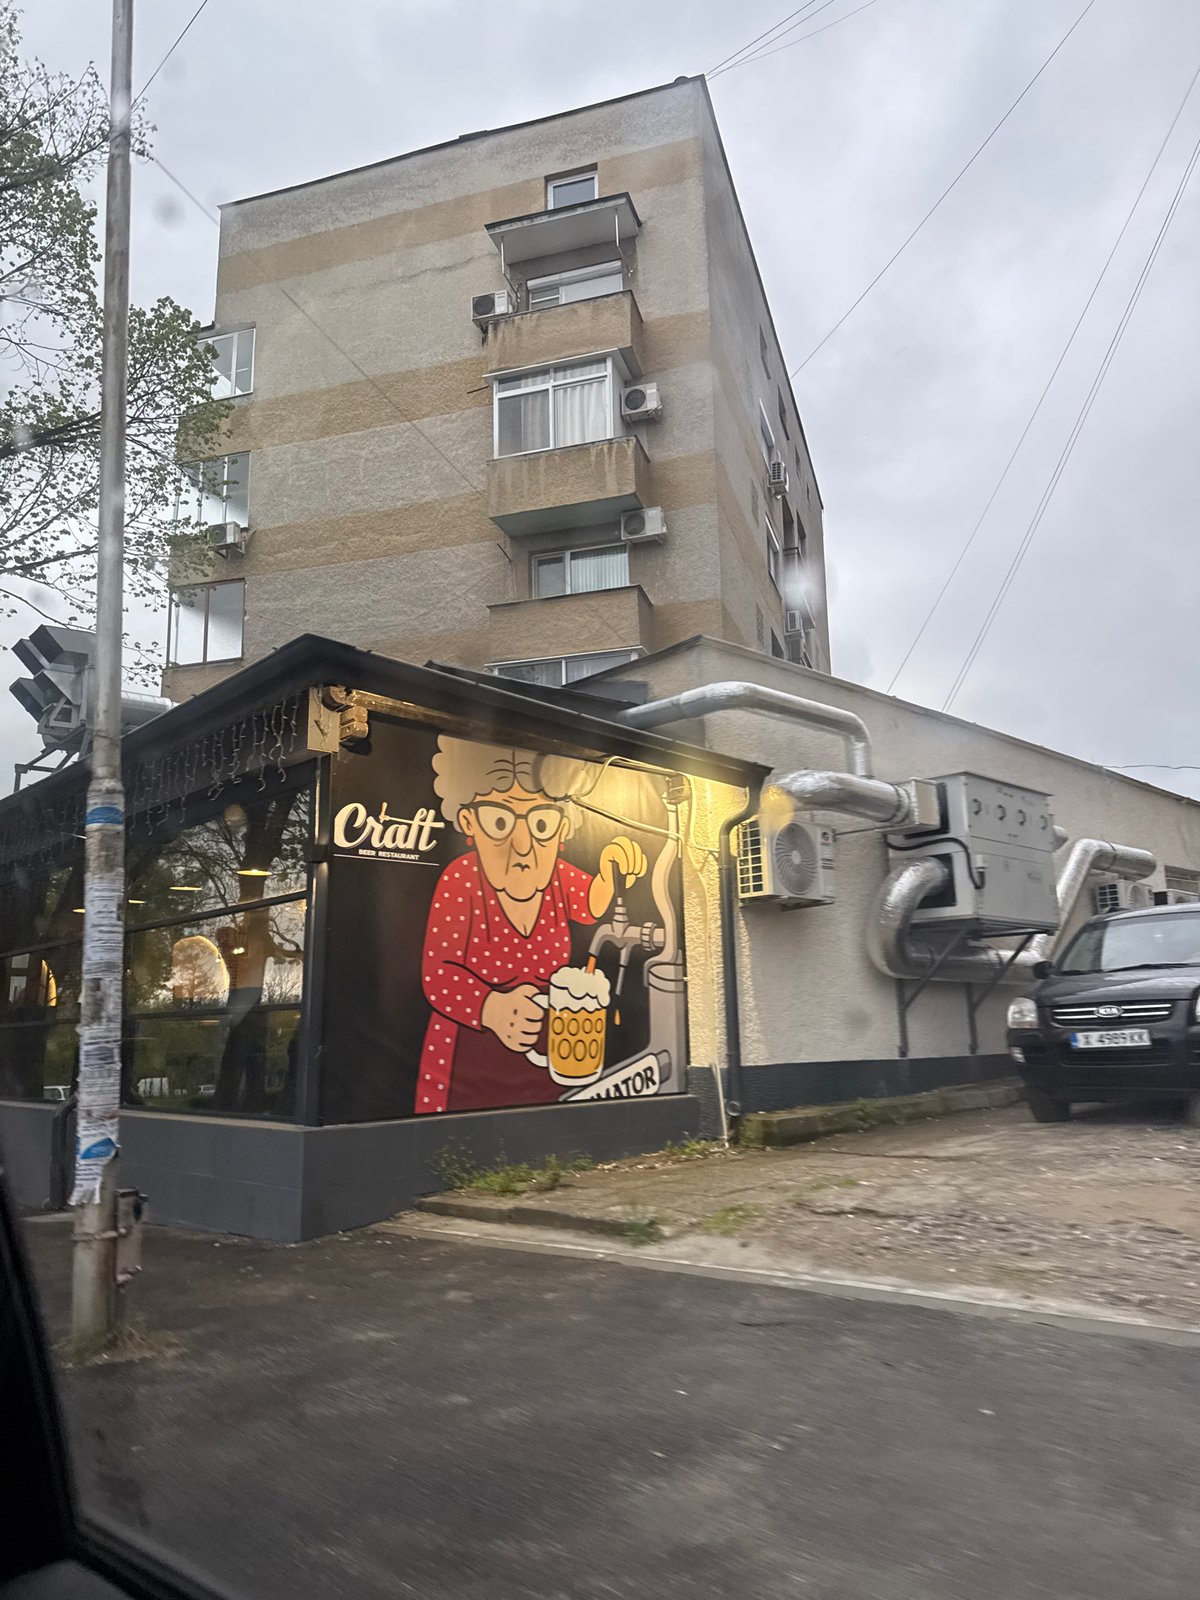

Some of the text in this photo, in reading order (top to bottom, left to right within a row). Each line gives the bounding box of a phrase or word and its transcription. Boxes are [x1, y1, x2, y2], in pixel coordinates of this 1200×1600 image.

[333, 802, 445, 852] Craft
[358, 849, 420, 860] BEER RESTAURANT
